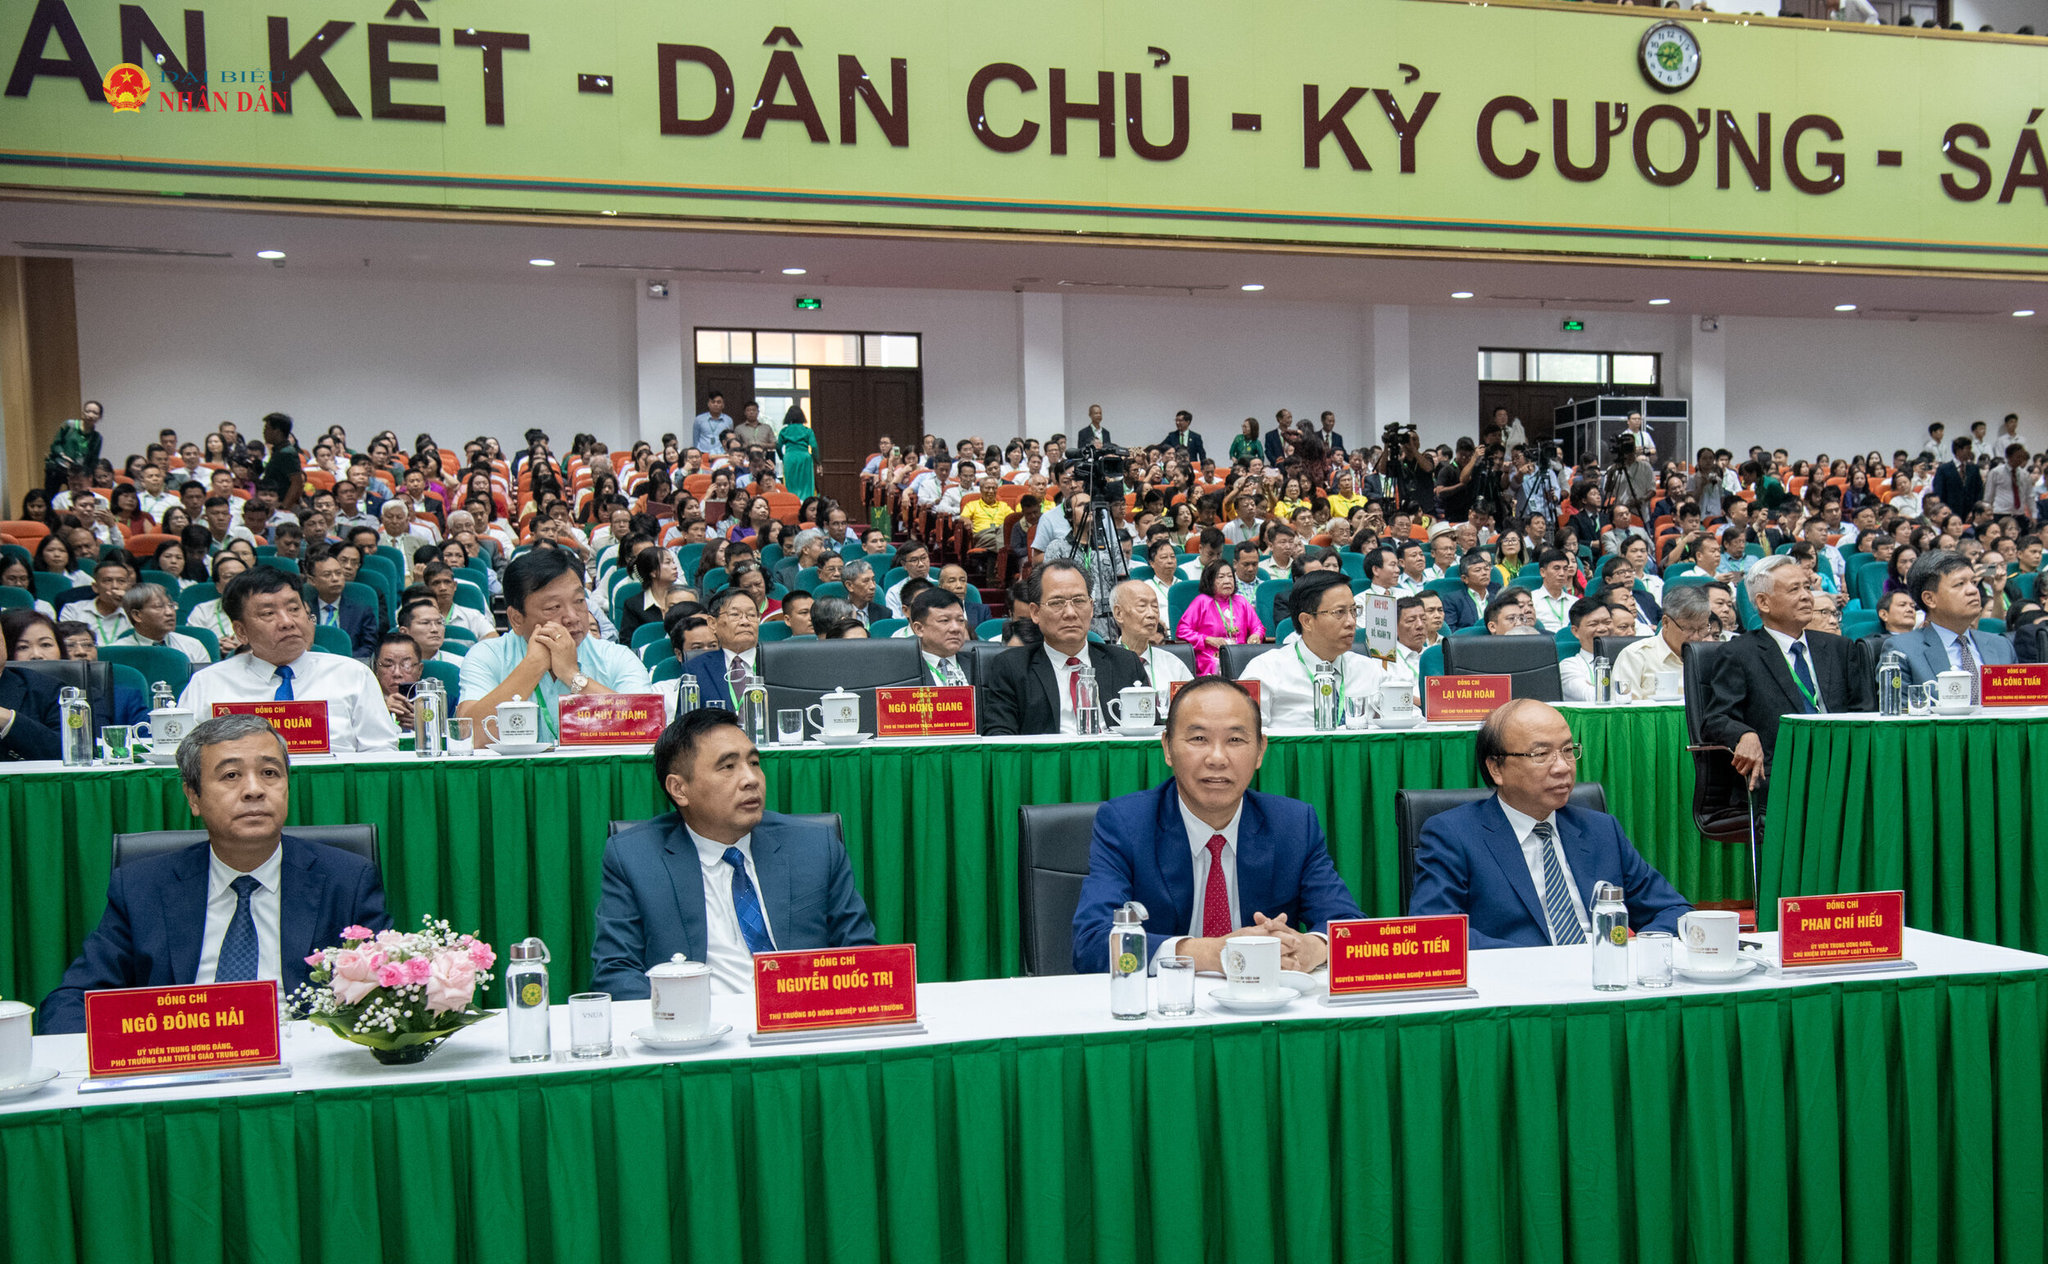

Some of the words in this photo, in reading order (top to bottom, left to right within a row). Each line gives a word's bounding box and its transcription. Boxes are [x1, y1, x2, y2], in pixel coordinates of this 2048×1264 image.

[656, 26, 909, 149] DÂN
[966, 46, 1190, 162] CHỦ
[1303, 63, 1441, 175] KỶ
[1476, 94, 1846, 195] CƯƠNG
[1992, 676, 2001, 686] HÀ
[2004, 676, 2022, 686] CÔNG
[2024, 675, 2041, 685] TUẤN
[1442, 690, 1454, 700] LẠI
[1457, 689, 1472, 698] VĂN
[1474, 688, 1495, 698] HOÀN
[888, 702, 907, 713] NGÔ
[909, 701, 933, 713] HỒNG
[936, 701, 963, 711] GIANG
[284, 716, 312, 729] QUÂN
[1826, 900, 1845, 910] ĐỒNG
[1847, 899, 1859, 909] CHÍ
[1801, 918, 1831, 931] PHAN
[1834, 913, 1854, 929] CHÍ
[1857, 908, 1883, 928] HIẾU
[1380, 924, 1401, 935] ĐỒNG
[1403, 923, 1417, 934] CHÍ
[1346, 941, 1389, 959] PHÙNG
[1393, 939, 1418, 955] ĐỨC
[1422, 935, 1450, 954] TIẾN
[813, 955, 837, 967] ĐỒNG
[840, 954, 856, 966] CHÍ
[777, 971, 828, 993] NGUYỄN
[833, 968, 868, 990] QUỐC
[872, 971, 893, 988] TRỊ
[157, 993, 186, 1006] ĐỒNG
[189, 991, 207, 1004] CHÍ
[808, 1010, 816, 1018] BỘ
[817, 1008, 834, 1017] NÔNG
[835, 1007, 857, 1016] NGHIỆP
[121, 1013, 157, 1034] NGÔ
[163, 1010, 211, 1030] ĐÔNG
[216, 1006, 244, 1026] HẢI
[148, 1046, 165, 1055] VIÊN
[166, 1045, 189, 1053] TRUNG
[190, 1043, 211, 1052] ƯƠNG
[212, 1041, 234, 1051] ĐẢNG,
[111, 1057, 126, 1067] PHÓ
[127, 1055, 157, 1066] TRƯỞNG
[158, 1055, 172, 1063] BAN
[174, 1052, 196, 1062] TUYÊN
[197, 1051, 215, 1060] GIÁO
[216, 1050, 239, 1059] TRUNG
[240, 1048, 259, 1057] ƯƠNG
